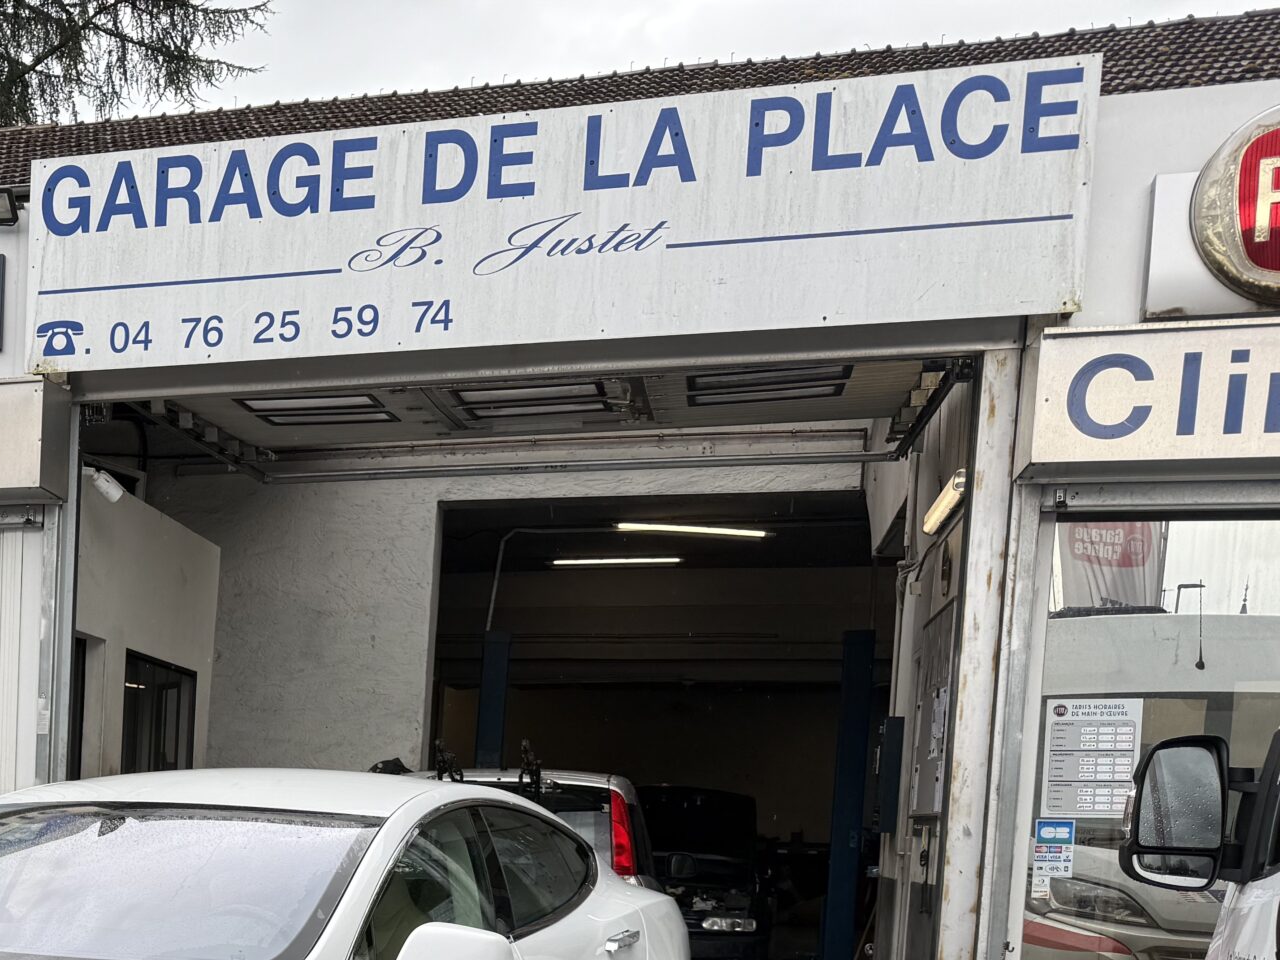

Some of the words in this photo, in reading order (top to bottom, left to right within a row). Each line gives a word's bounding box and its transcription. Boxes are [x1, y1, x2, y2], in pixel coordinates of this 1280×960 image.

[41, 136, 379, 237] GARAGE
[421, 121, 539, 205] DE
[582, 107, 697, 192] LA
[746, 67, 1084, 178] PLACE
[347, 224, 444, 272] B.
[473, 212, 669, 276] Justet
[109, 321, 153, 354] 04
[181, 316, 224, 349] 76
[253, 311, 300, 343] 25
[331, 304, 379, 339] 59
[412, 299, 453, 333] 74
[1066, 348, 1280, 440] Cli
